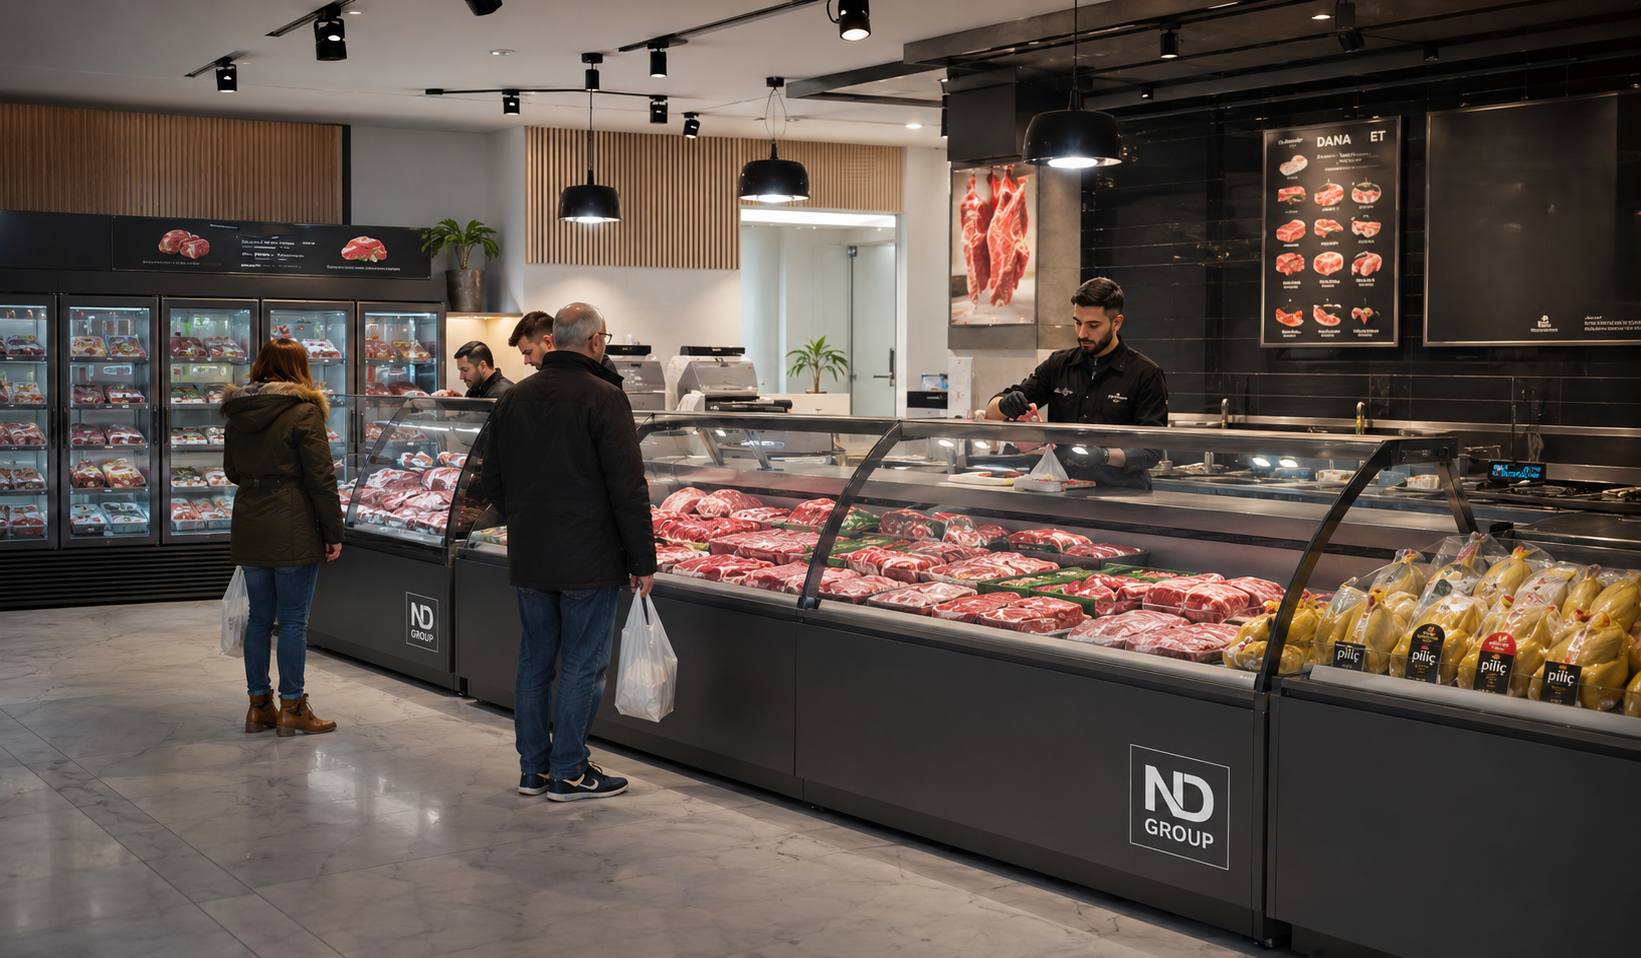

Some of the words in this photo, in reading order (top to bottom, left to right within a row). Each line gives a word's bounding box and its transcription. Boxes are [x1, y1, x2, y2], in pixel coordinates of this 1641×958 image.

[1316, 133, 1352, 148] DANA
[1370, 130, 1387, 142] ET
[411, 602, 434, 630] ND
[411, 629, 434, 642] GROUP
[1411, 649, 1437, 666] piliç
[1480, 659, 1508, 676] piliç
[1546, 669, 1576, 687] piliç
[1145, 764, 1215, 823] ND
[1144, 818, 1215, 849] GROUP
